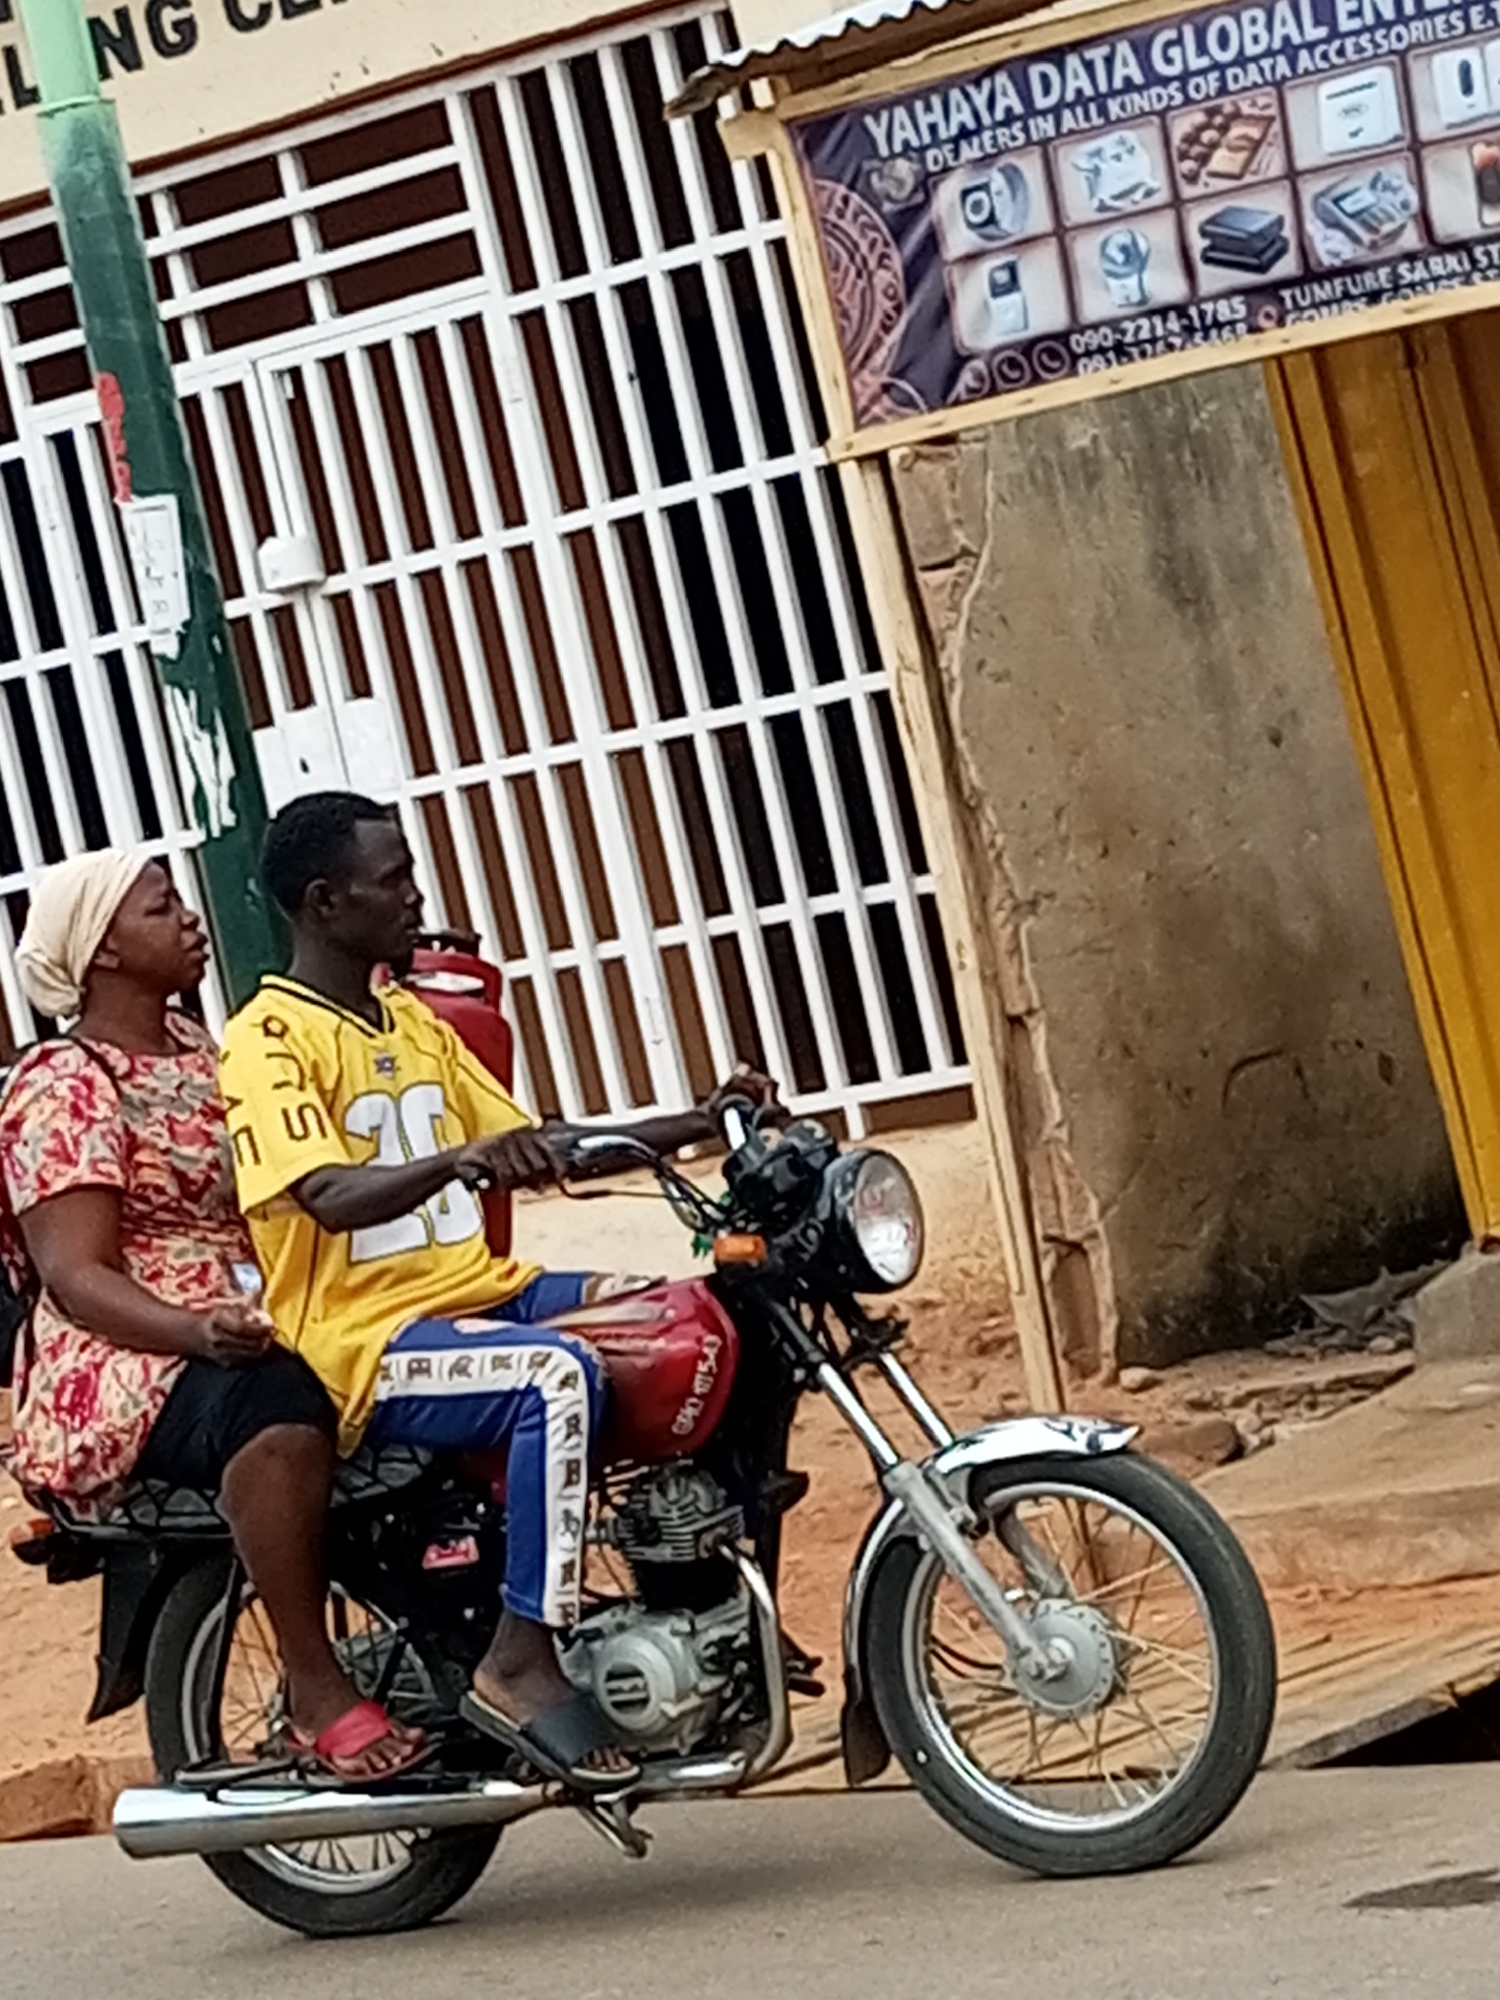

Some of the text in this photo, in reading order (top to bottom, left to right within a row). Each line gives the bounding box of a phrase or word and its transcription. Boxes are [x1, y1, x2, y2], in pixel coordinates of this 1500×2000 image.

[864, 70, 1025, 157] YAHAYA
[1028, 39, 1145, 110] DATA
[1151, 0, 1329, 77] GLOBAL
[925, 124, 1027, 172] DEALERS
[1028, 113, 1057, 142] IN
[1060, 101, 1103, 134] ALL
[1106, 84, 1182, 122] KINDS
[1187, 69, 1223, 101] OF
[1224, 55, 1292, 92] DATA
[1298, 11, 1465, 74] ACCESSORIES
[1069, 296, 1247, 354] 090-2214-1785
[1279, 266, 1393, 310] TUMFURE
